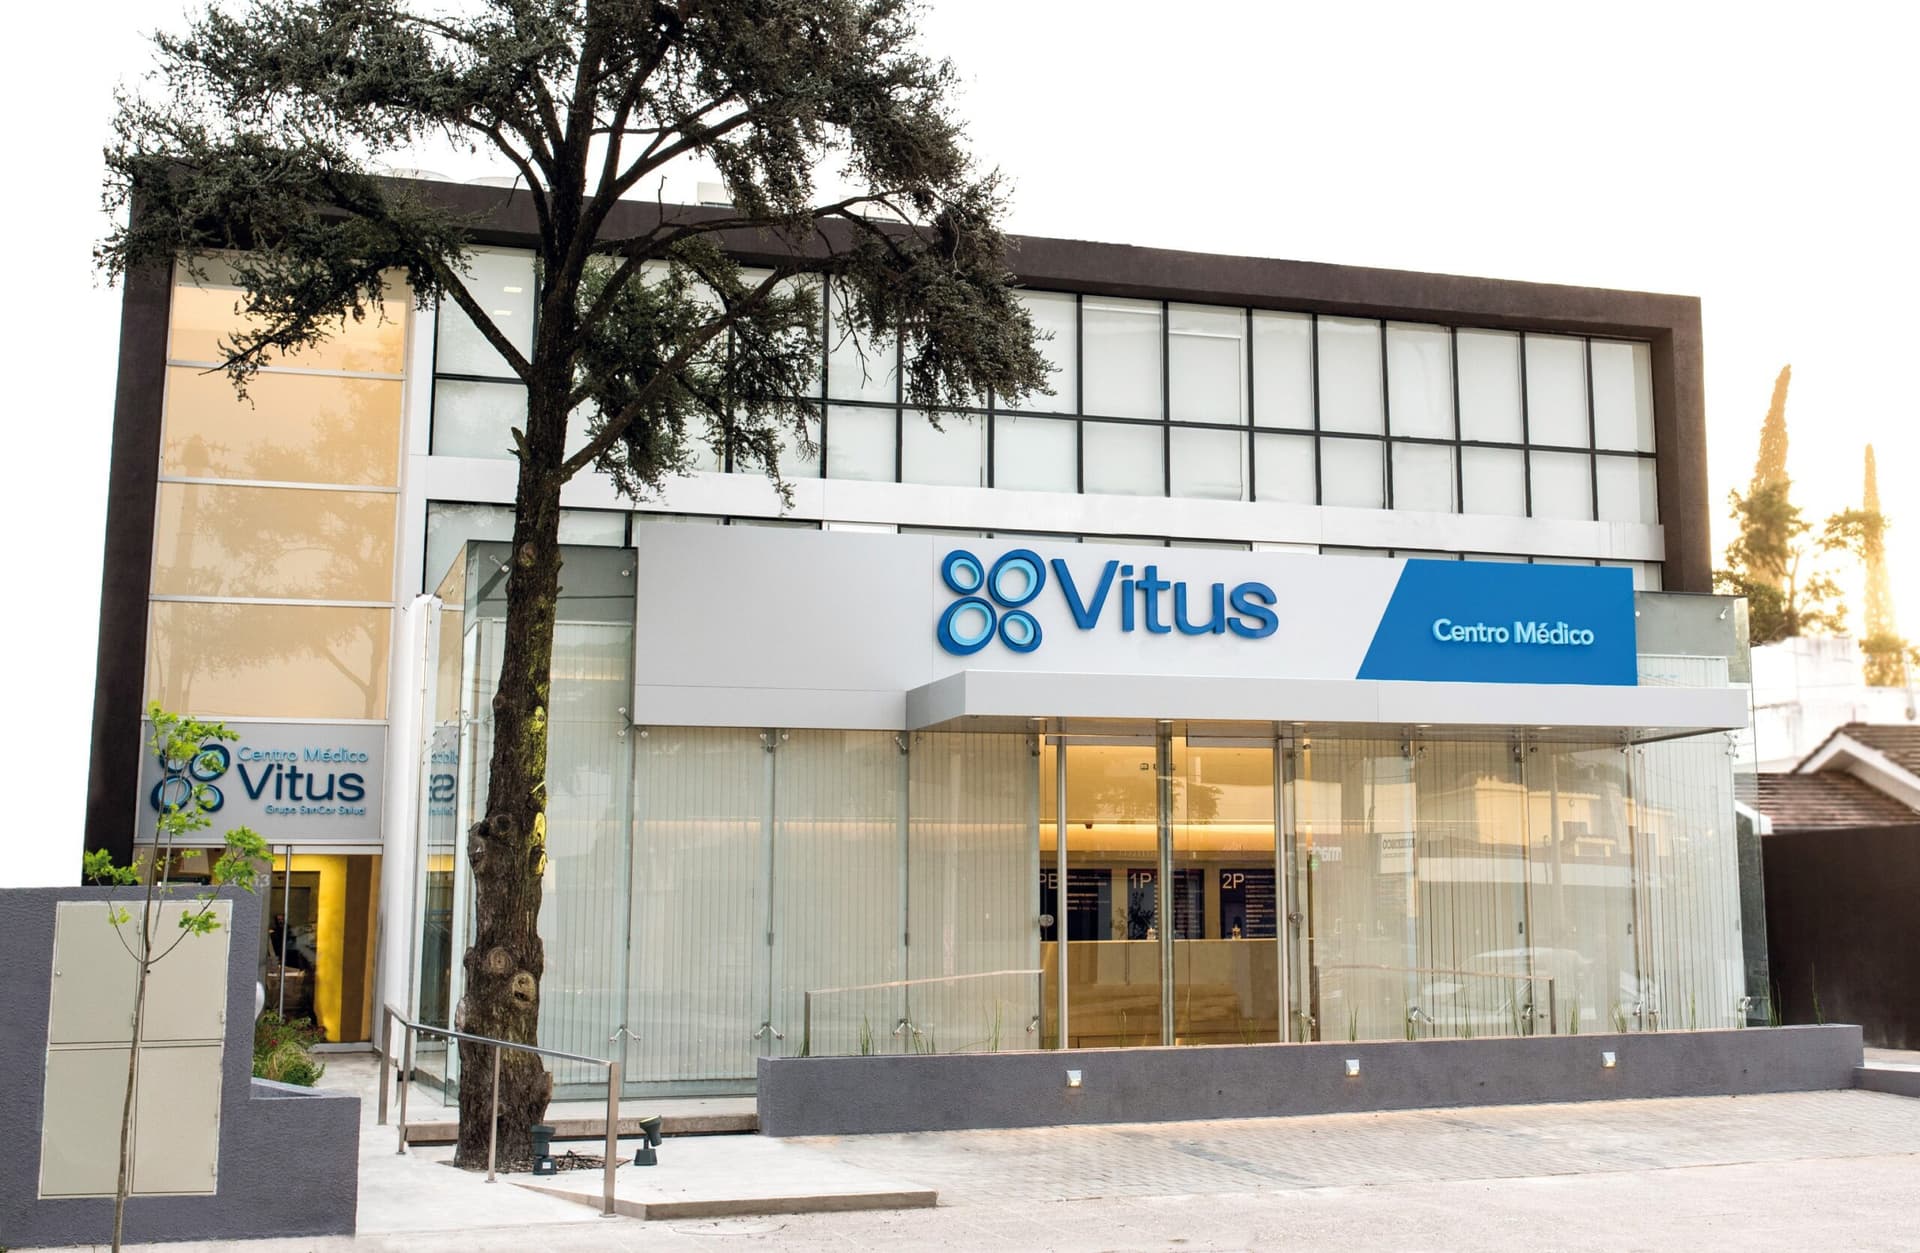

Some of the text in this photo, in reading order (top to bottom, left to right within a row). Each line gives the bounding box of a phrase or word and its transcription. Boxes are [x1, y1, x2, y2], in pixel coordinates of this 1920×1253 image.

[1051, 559, 1279, 639] Vitus
[1432, 618, 1596, 647] Centro Médico
[237, 747, 368, 763] Centro Médico
[237, 763, 366, 802] Vitus
[266, 805, 366, 816] Grupo SanCor Salud
[1130, 873, 1152, 889] 1P
[1223, 873, 1245, 889] 2P
